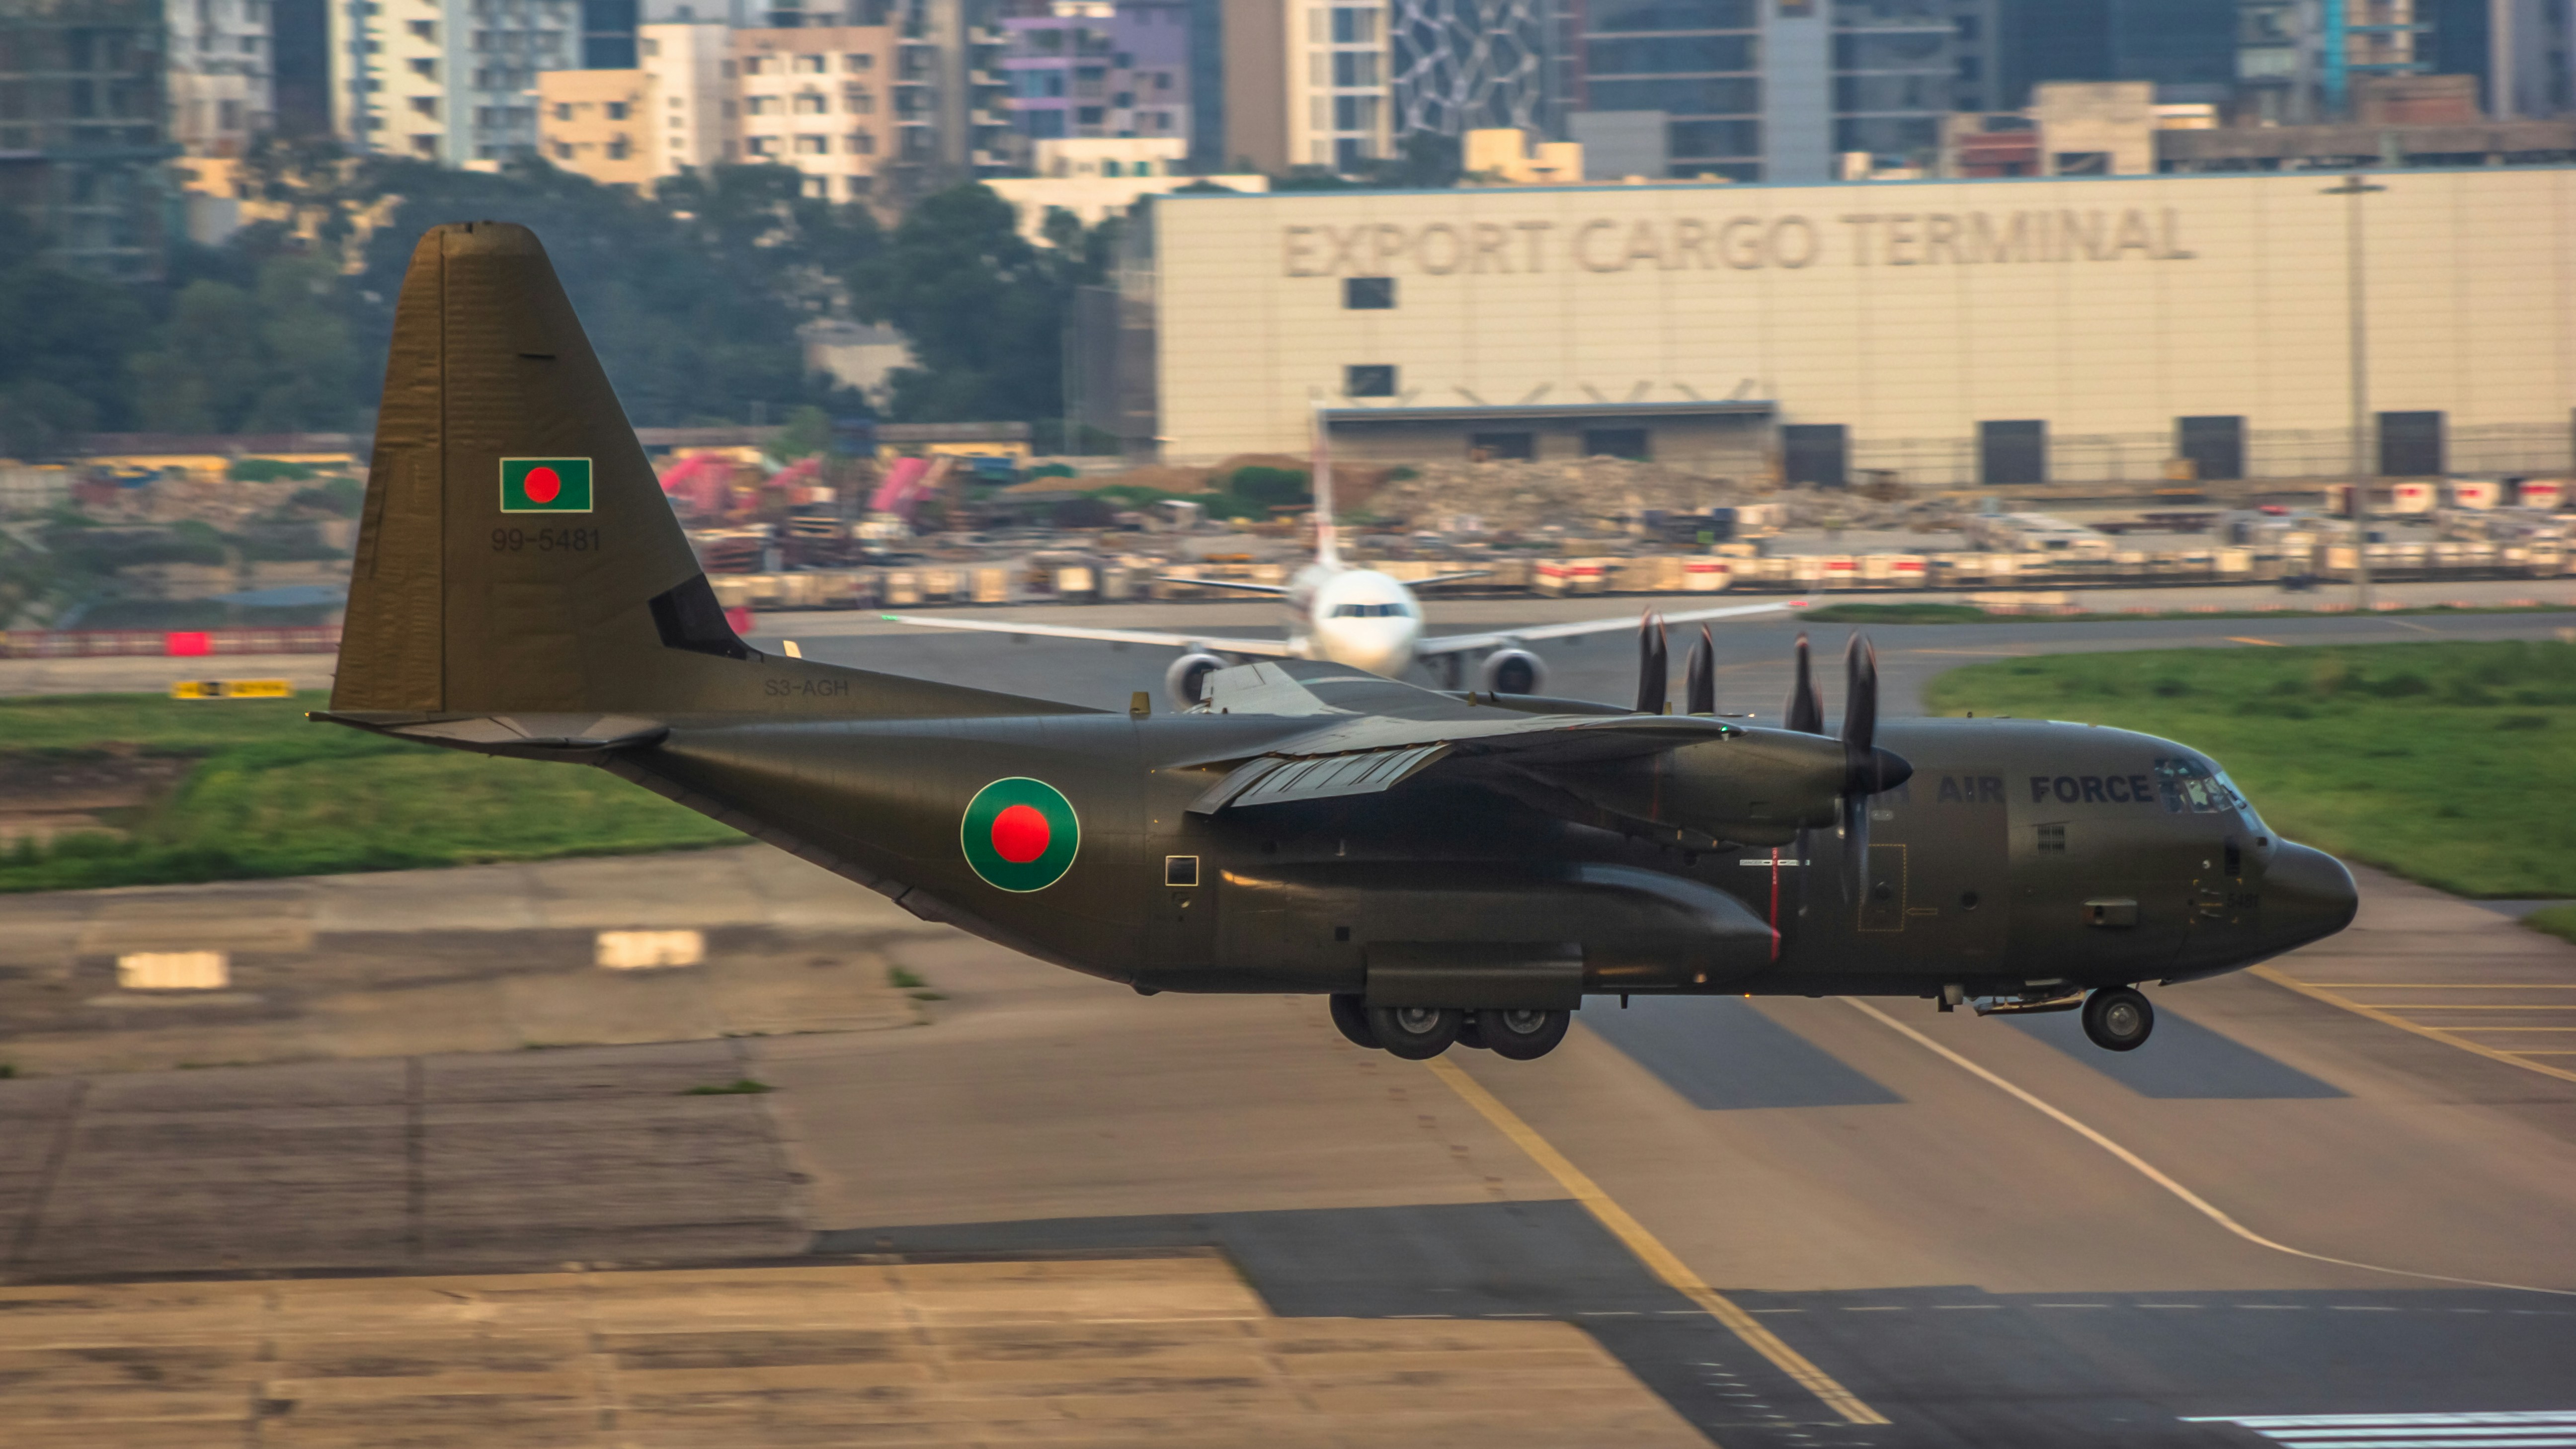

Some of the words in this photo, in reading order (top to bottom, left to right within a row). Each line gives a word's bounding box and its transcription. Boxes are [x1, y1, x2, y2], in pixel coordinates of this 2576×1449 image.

[1282, 221, 1554, 277] EXPORT
[1572, 215, 1819, 273] CARGO
[1838, 208, 2196, 265] TERMINAL
[492, 528, 599, 552] 99-5481
[765, 679, 848, 696] S3-AGH
[1937, 776, 2006, 804] AIR
[2029, 774, 2154, 804] FORCE
